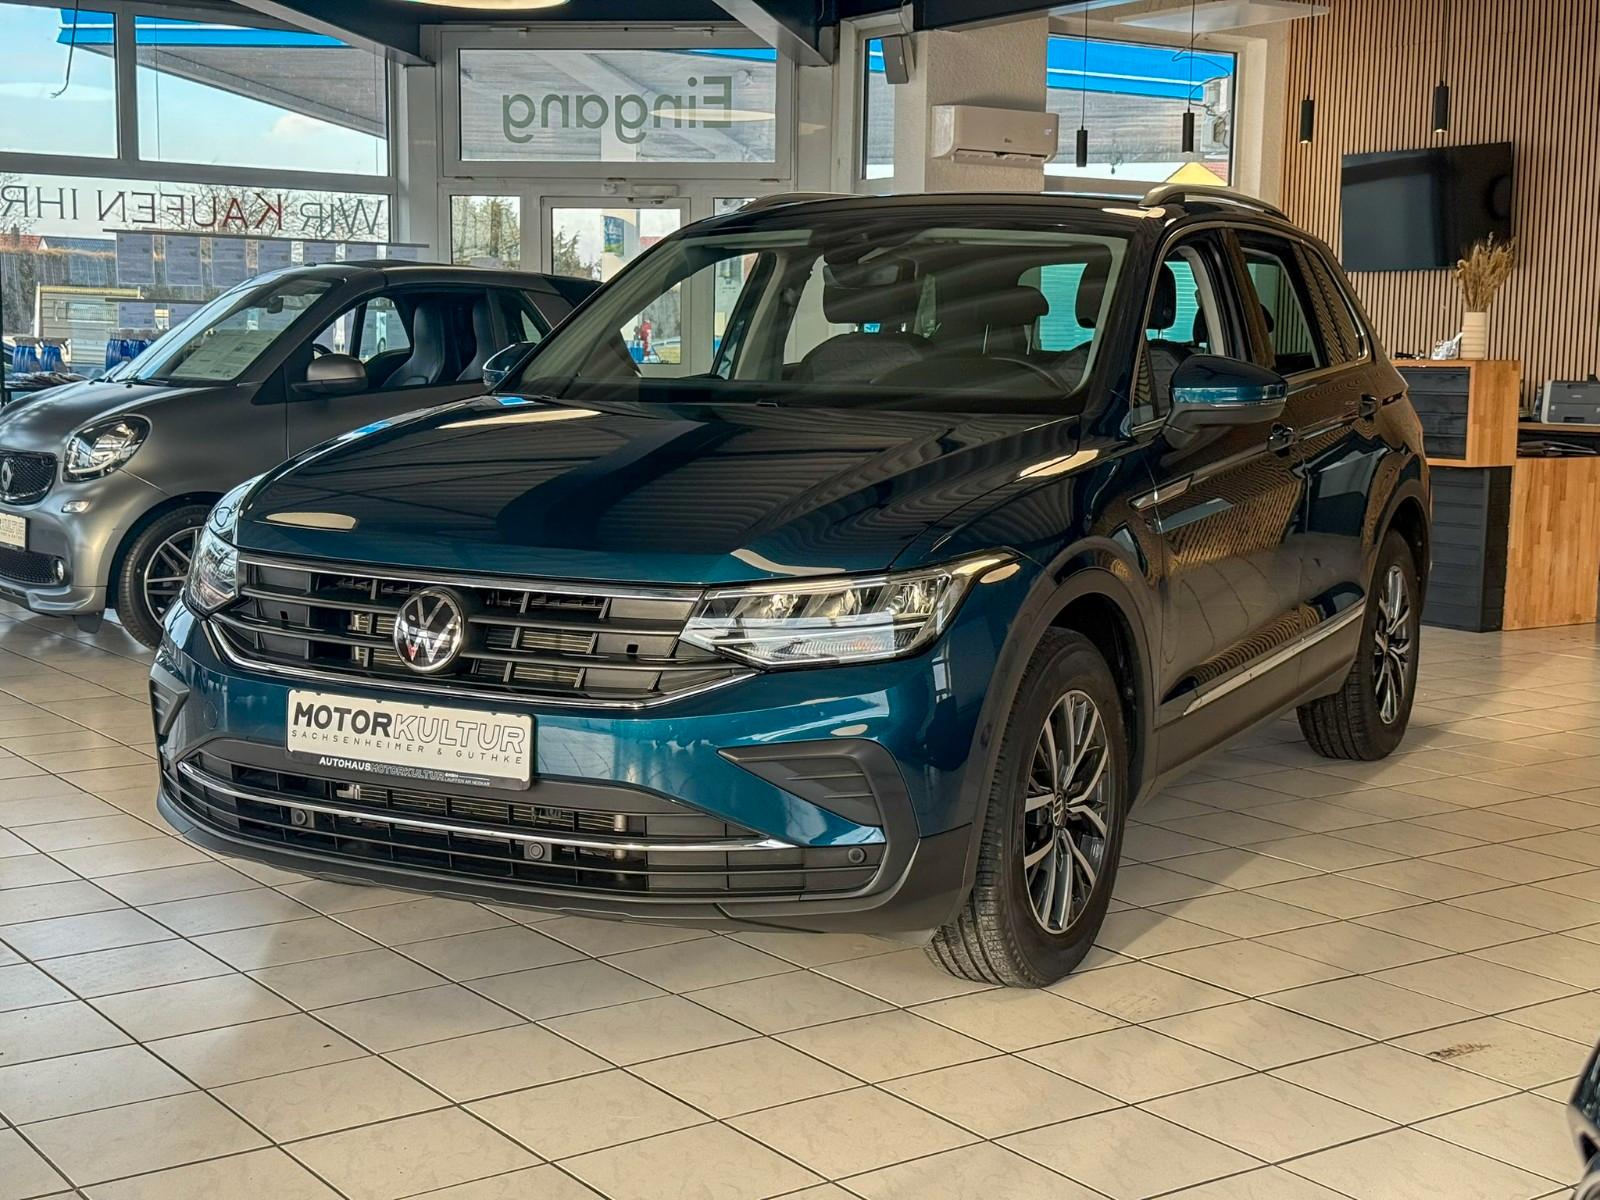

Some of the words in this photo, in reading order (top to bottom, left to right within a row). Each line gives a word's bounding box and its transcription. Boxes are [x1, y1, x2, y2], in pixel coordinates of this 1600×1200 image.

[291, 730, 424, 753] SACHSENHEIMER
[456, 750, 522, 765] GUTHKE
[293, 702, 525, 754] MOTORKULTUR
